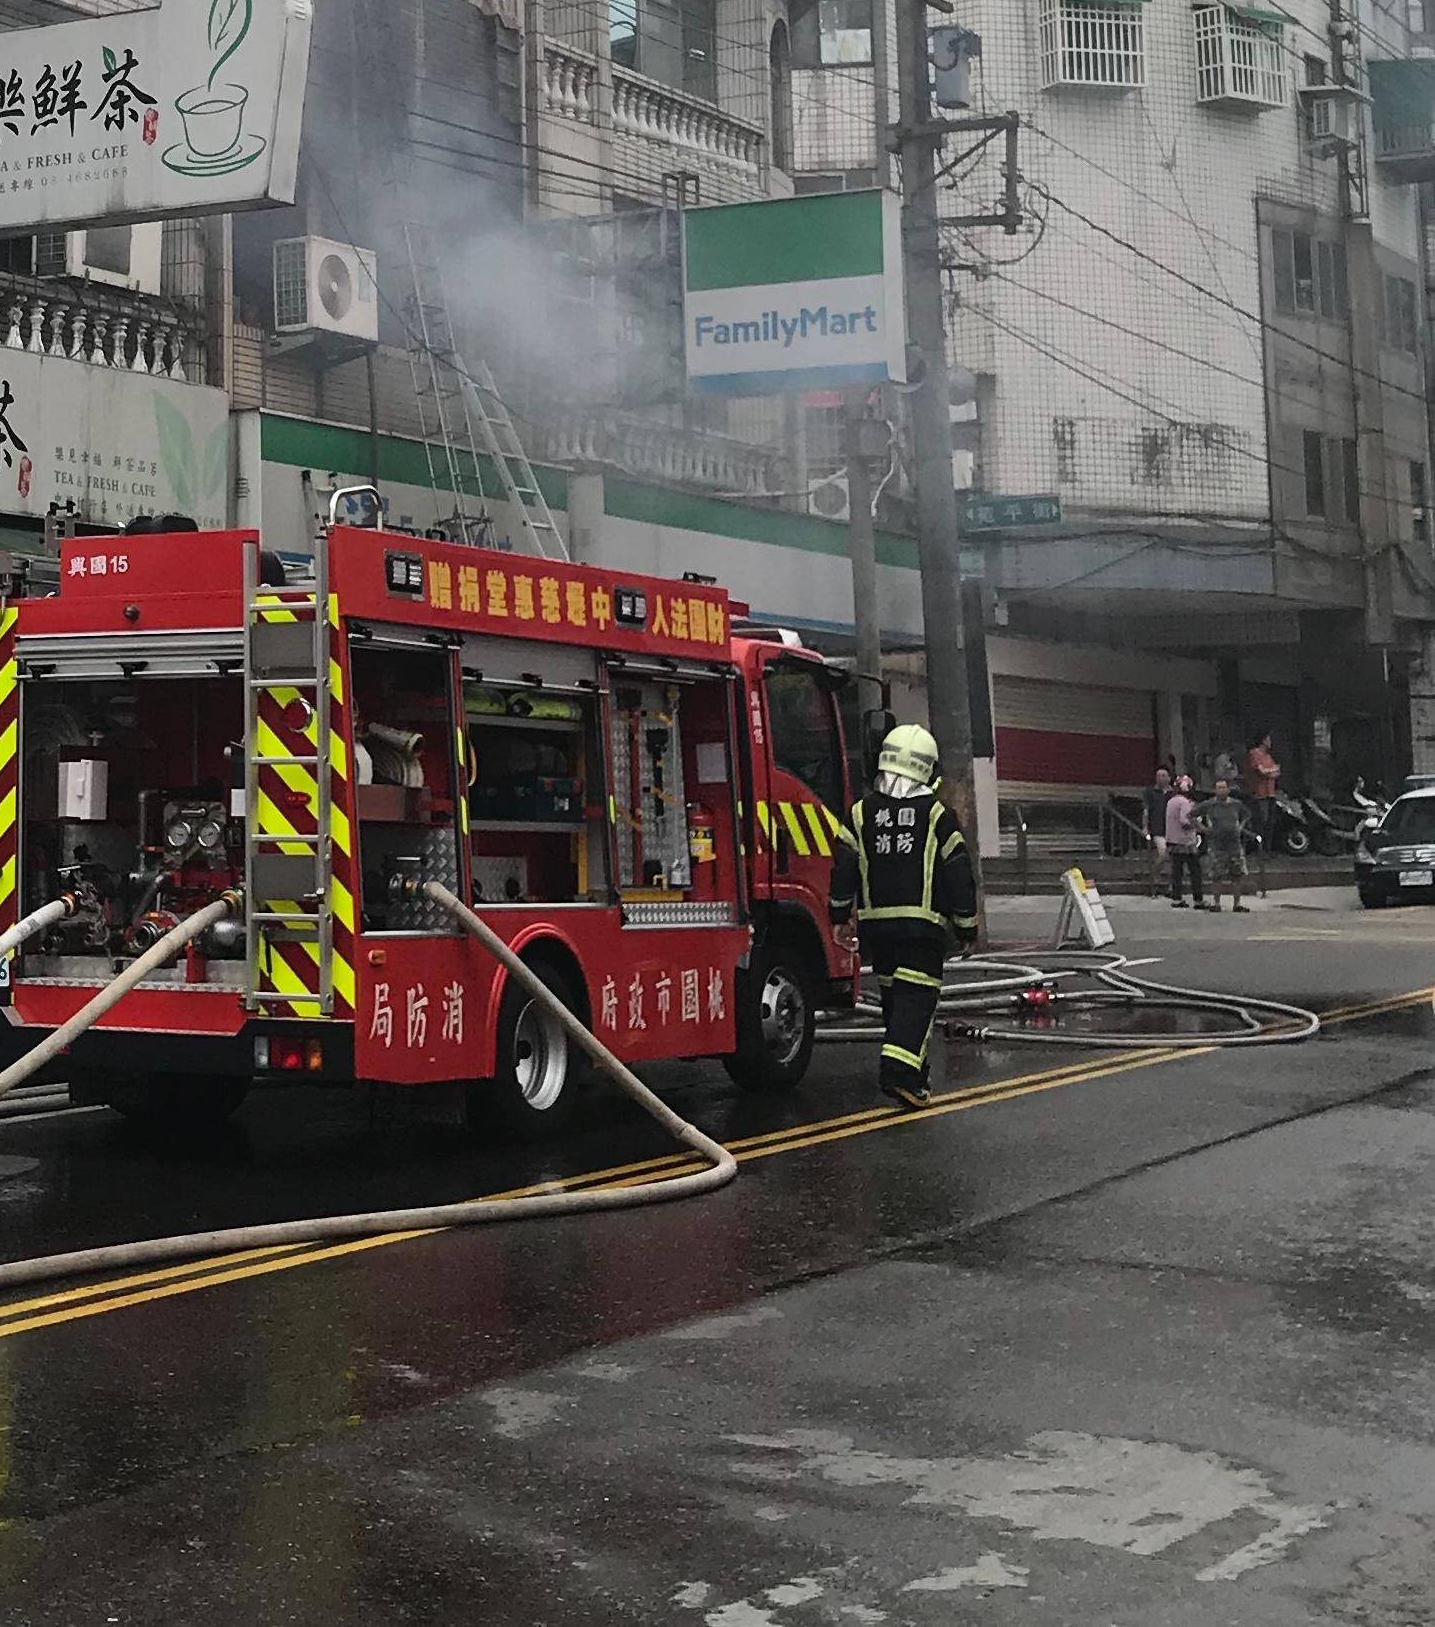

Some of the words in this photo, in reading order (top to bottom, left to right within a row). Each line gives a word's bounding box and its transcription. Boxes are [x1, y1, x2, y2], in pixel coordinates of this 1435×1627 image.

[27, 152, 72, 169] FRESH
[91, 144, 129, 161] CAFE
[695, 305, 878, 348] FamilyMart
[54, 470, 74, 485] TEA
[87, 475, 119, 492] FRESH
[131, 482, 156, 497] CAFE
[875, 832, 915, 854] 消防
